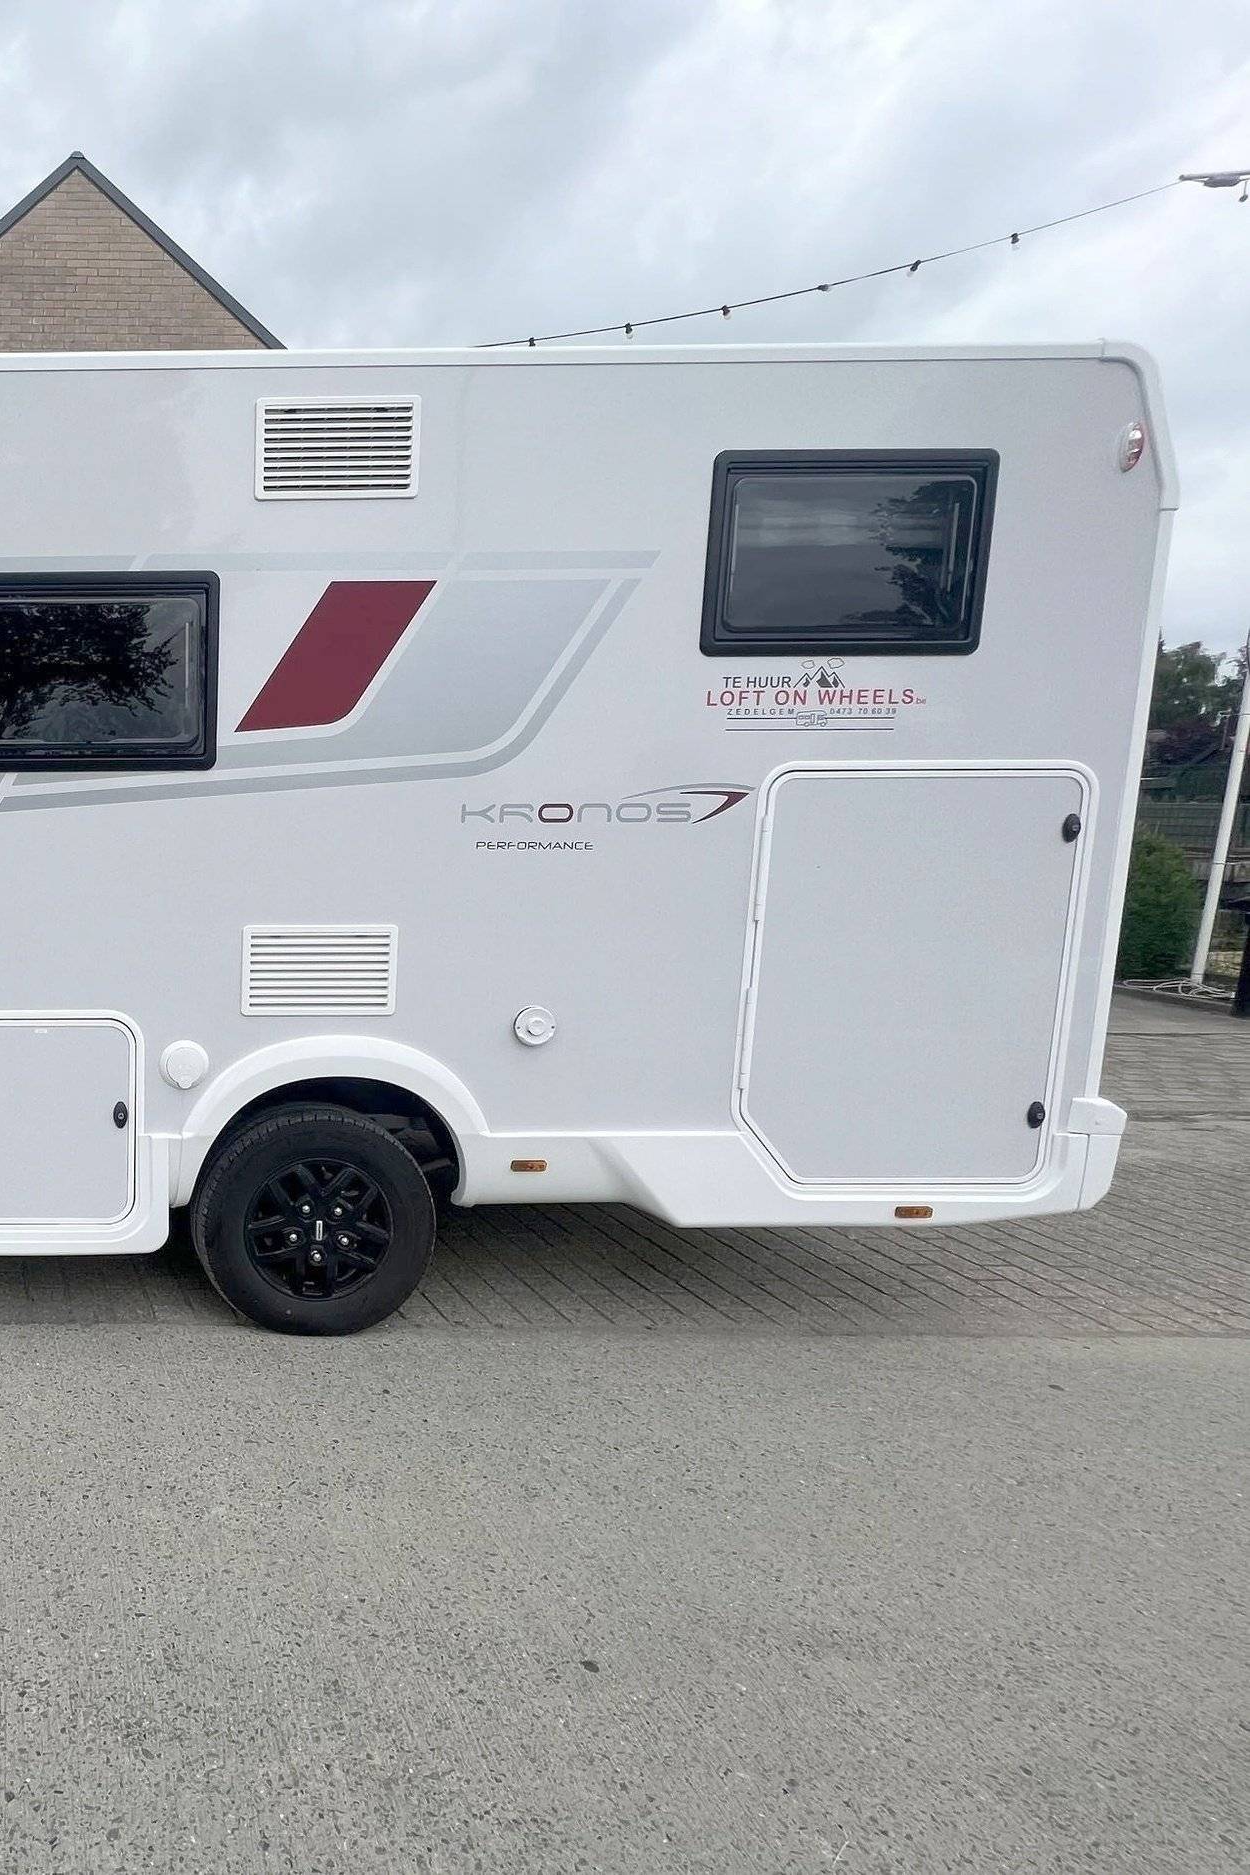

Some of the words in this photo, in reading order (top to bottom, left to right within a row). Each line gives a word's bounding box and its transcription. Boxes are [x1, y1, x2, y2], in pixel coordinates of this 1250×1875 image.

[722, 676, 742, 688] TE
[746, 676, 792, 688] HUUR
[706, 690, 766, 706] LOFT
[775, 690, 807, 705] ON
[726, 708, 795, 716] ZEDELGEM
[829, 707, 853, 715] 0473
[460, 803, 693, 824] KRONOS
[475, 841, 594, 851] PERFORMANCE
